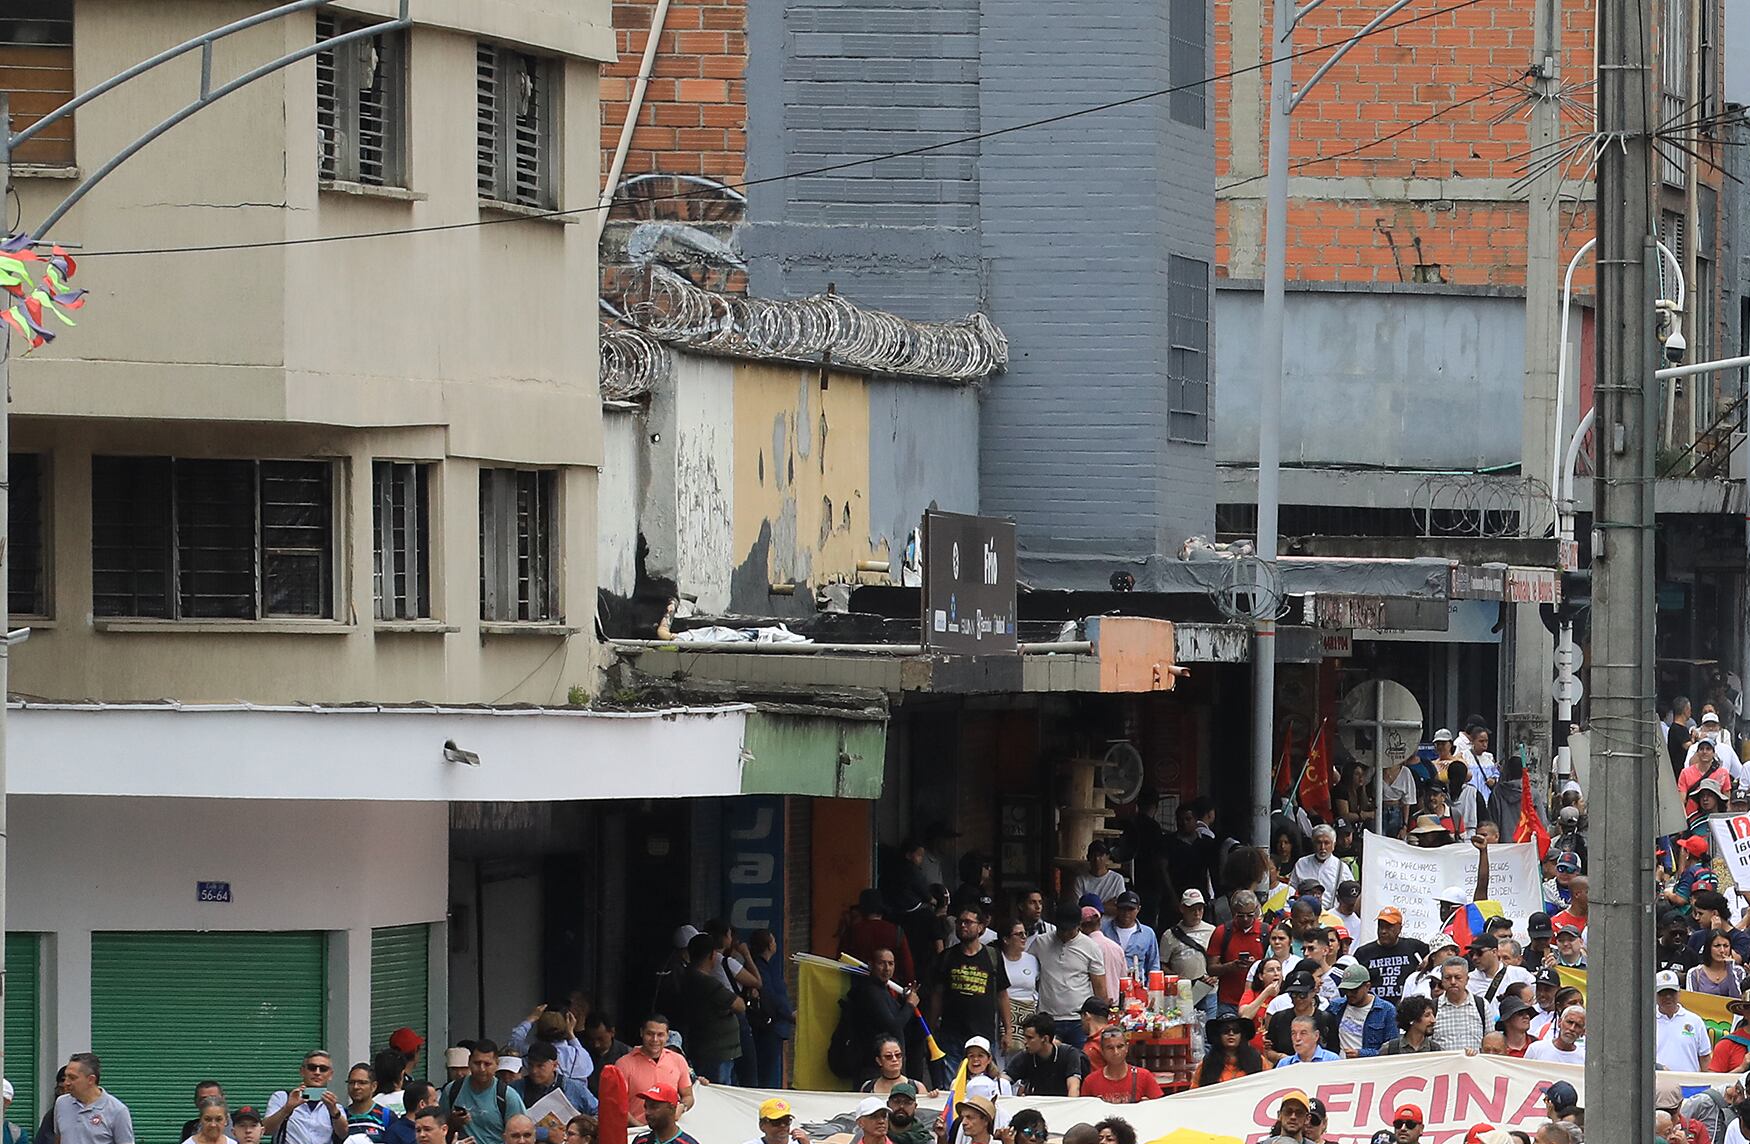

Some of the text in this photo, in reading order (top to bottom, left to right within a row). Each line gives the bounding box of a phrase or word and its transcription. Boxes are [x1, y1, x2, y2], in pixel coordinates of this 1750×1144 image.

[201, 889, 229, 901] 56-64
[1368, 956, 1410, 969] ARRIBA
[1379, 966, 1402, 977] LOS
[1382, 977, 1398, 986] DE
[1252, 1072, 1554, 1127] OFICINA
